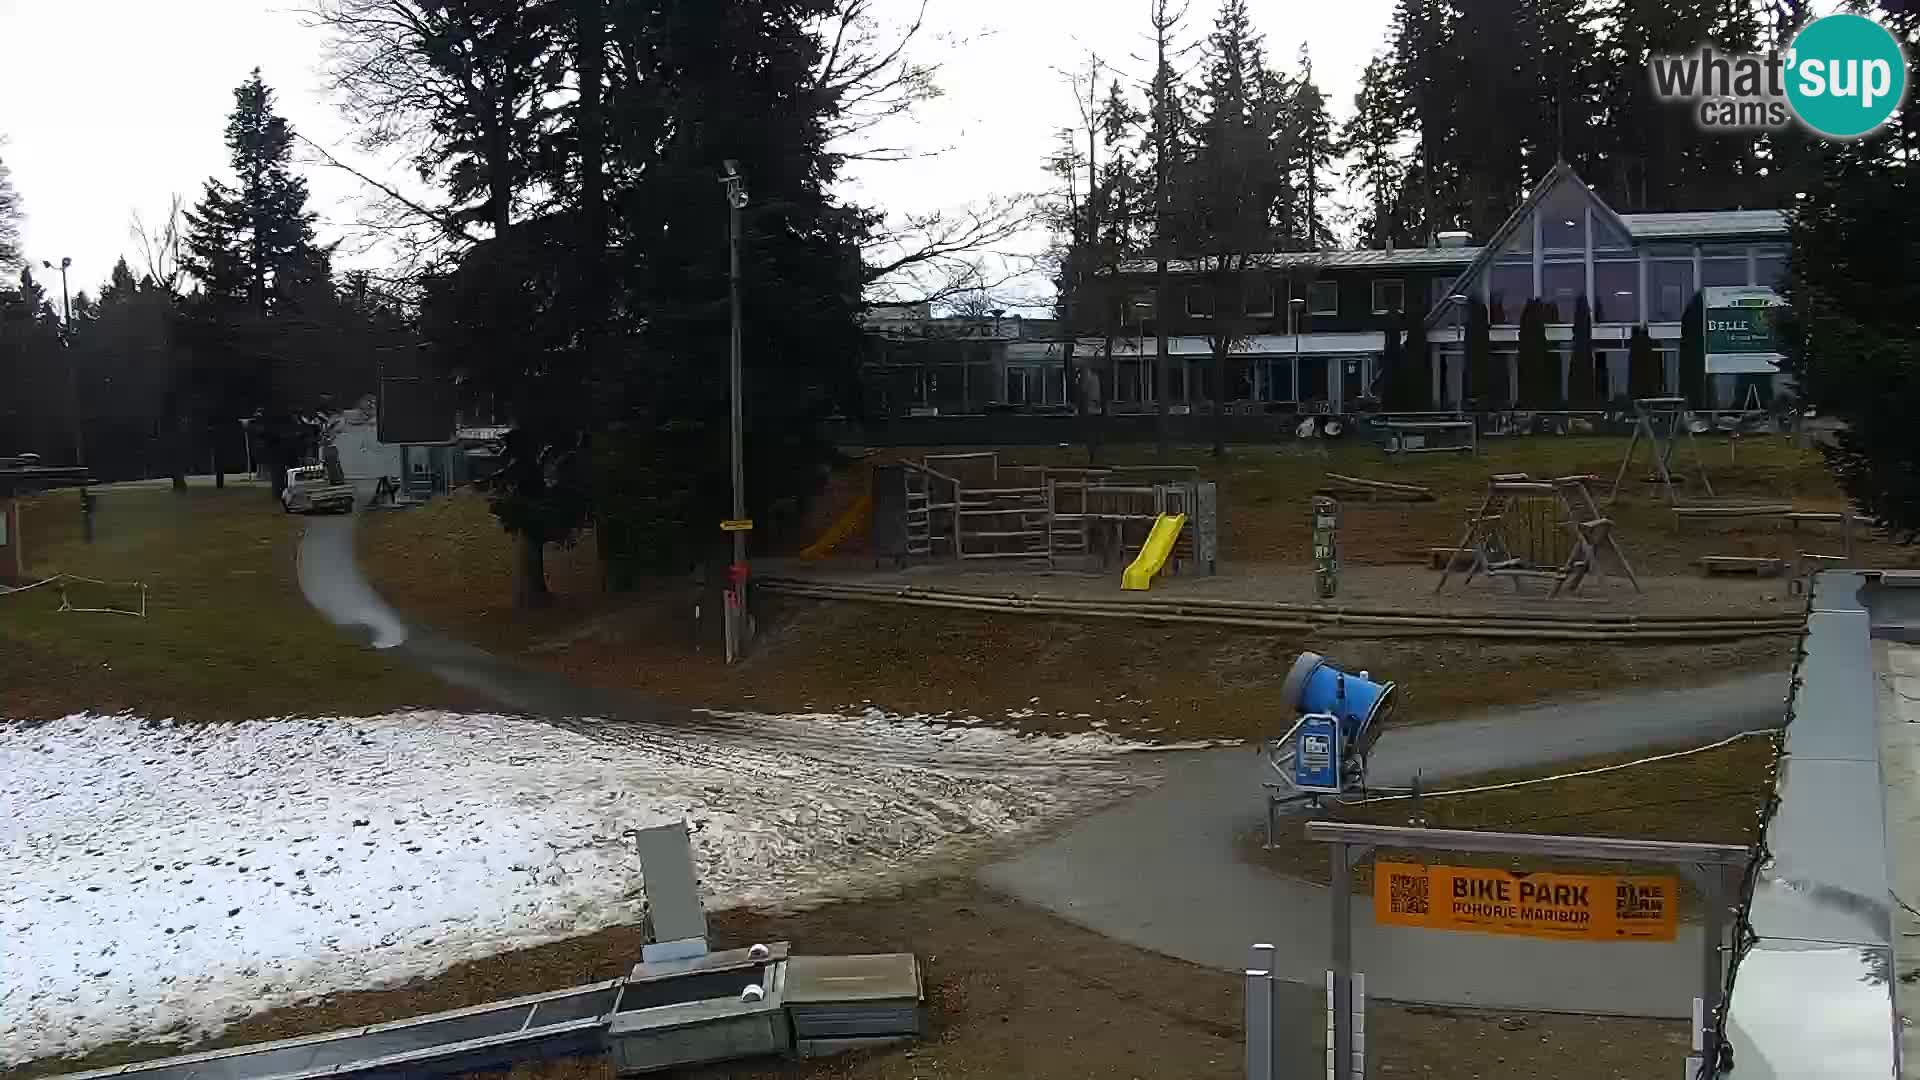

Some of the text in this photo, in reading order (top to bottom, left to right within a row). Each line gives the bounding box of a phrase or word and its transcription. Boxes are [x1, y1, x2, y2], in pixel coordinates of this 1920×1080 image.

[1707, 319, 1749, 331] BELLE
[1452, 876, 1590, 906] BIKE PARK
[1520, 907, 1591, 923] MARIBOR
